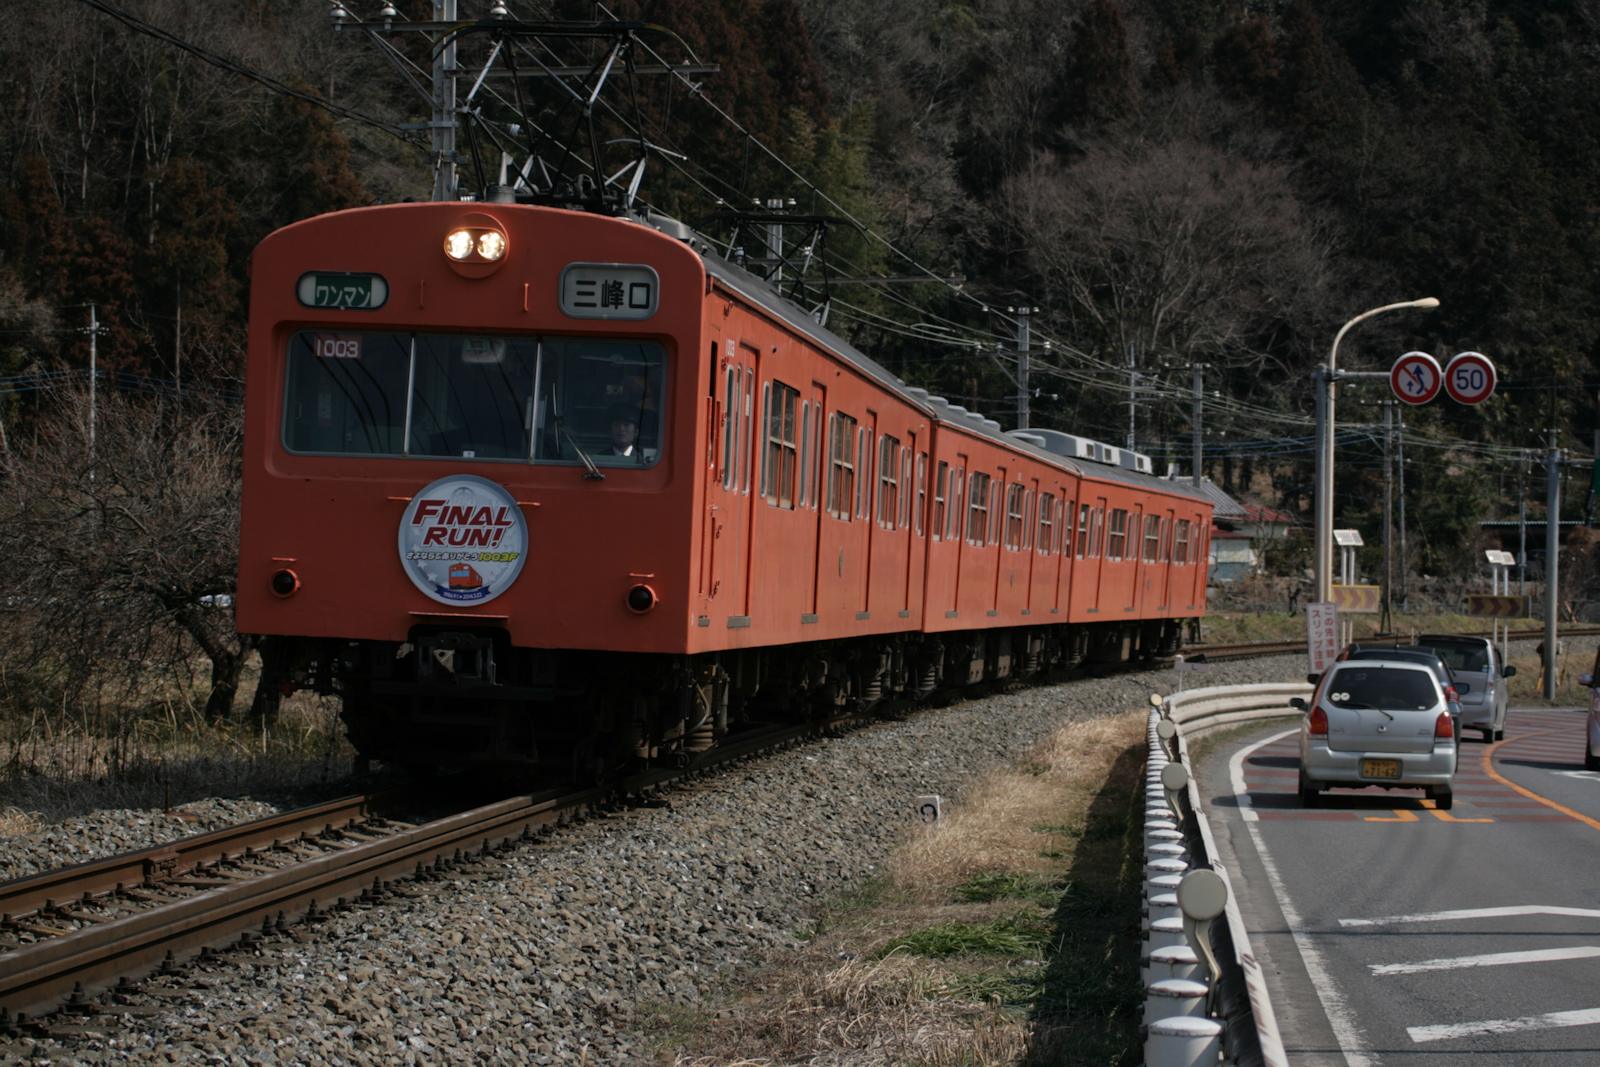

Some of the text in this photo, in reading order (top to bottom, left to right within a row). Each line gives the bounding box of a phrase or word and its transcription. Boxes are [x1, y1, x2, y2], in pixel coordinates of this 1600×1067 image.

[316, 286, 371, 307] ワンマン
[573, 280, 651, 310] 三峰口
[316, 339, 359, 358] 1003
[1456, 369, 1484, 390] 50
[411, 499, 514, 526] FINAL
[422, 527, 505, 547] RUN!
